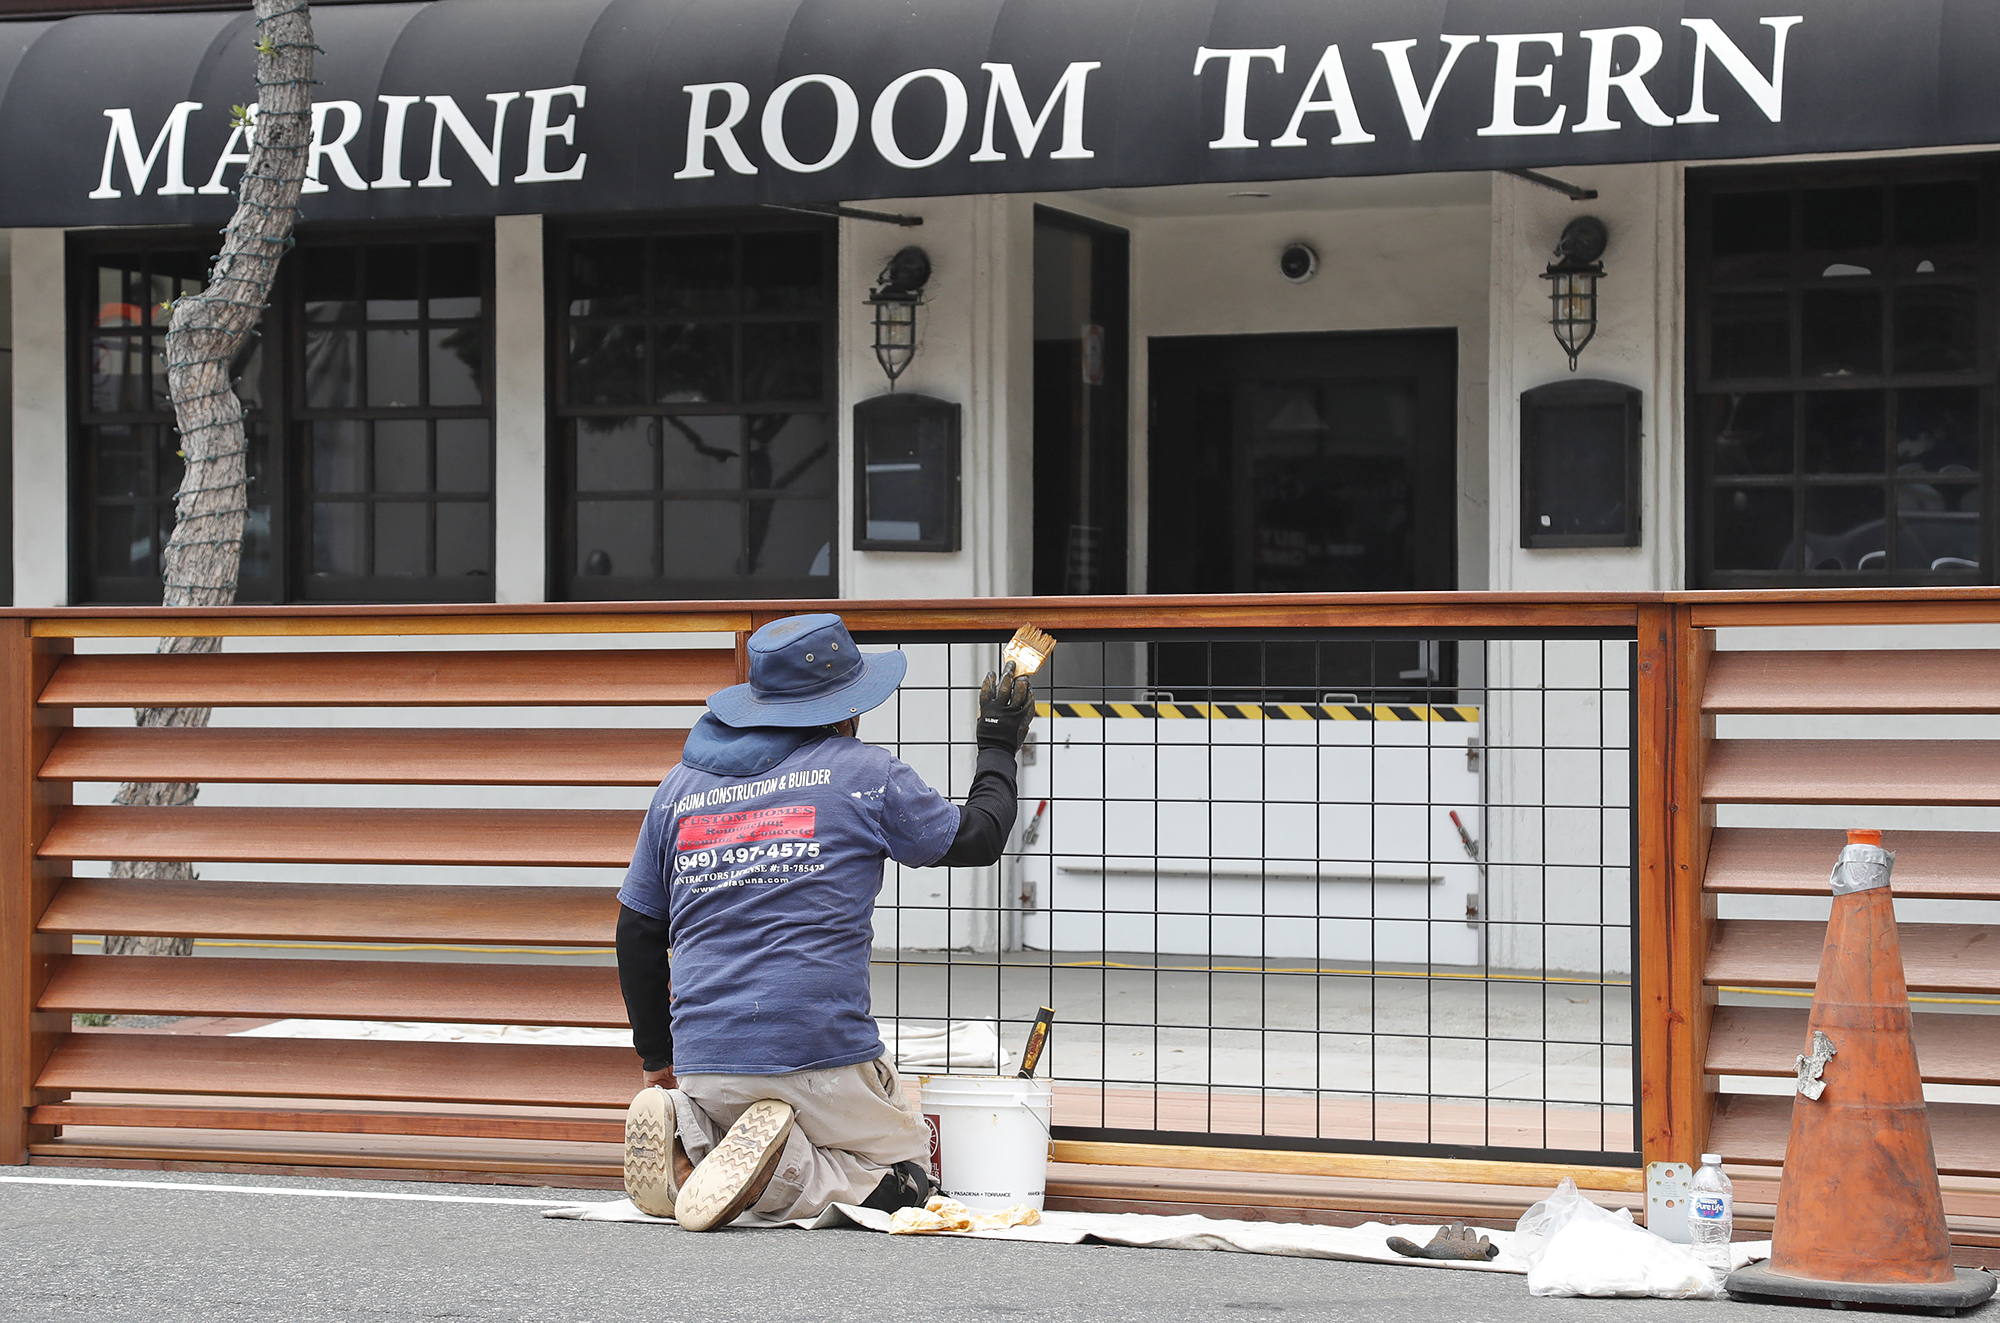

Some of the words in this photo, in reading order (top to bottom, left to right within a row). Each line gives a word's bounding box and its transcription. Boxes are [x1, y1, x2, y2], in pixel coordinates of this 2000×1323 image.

[88, 84, 588, 199] MARINE
[673, 61, 1102, 180] ROOM
[1192, 15, 1804, 149] TAVERN
[706, 777, 778, 806] CONSTRUCTION
[778, 775, 787, 790] &
[788, 768, 831, 789] BUILDER
[681, 813, 748, 826] CUSTOM
[753, 807, 814, 819] HOMES
[705, 820, 783, 835] Remodeling
[736, 832, 746, 840] &
[750, 828, 813, 838] Concrete
[674, 849, 718, 873] (949)
[721, 842, 820, 864] 497-4575
[674, 871, 729, 885] ONTRACTORS
[1696, 1201, 1711, 1211] Pure
